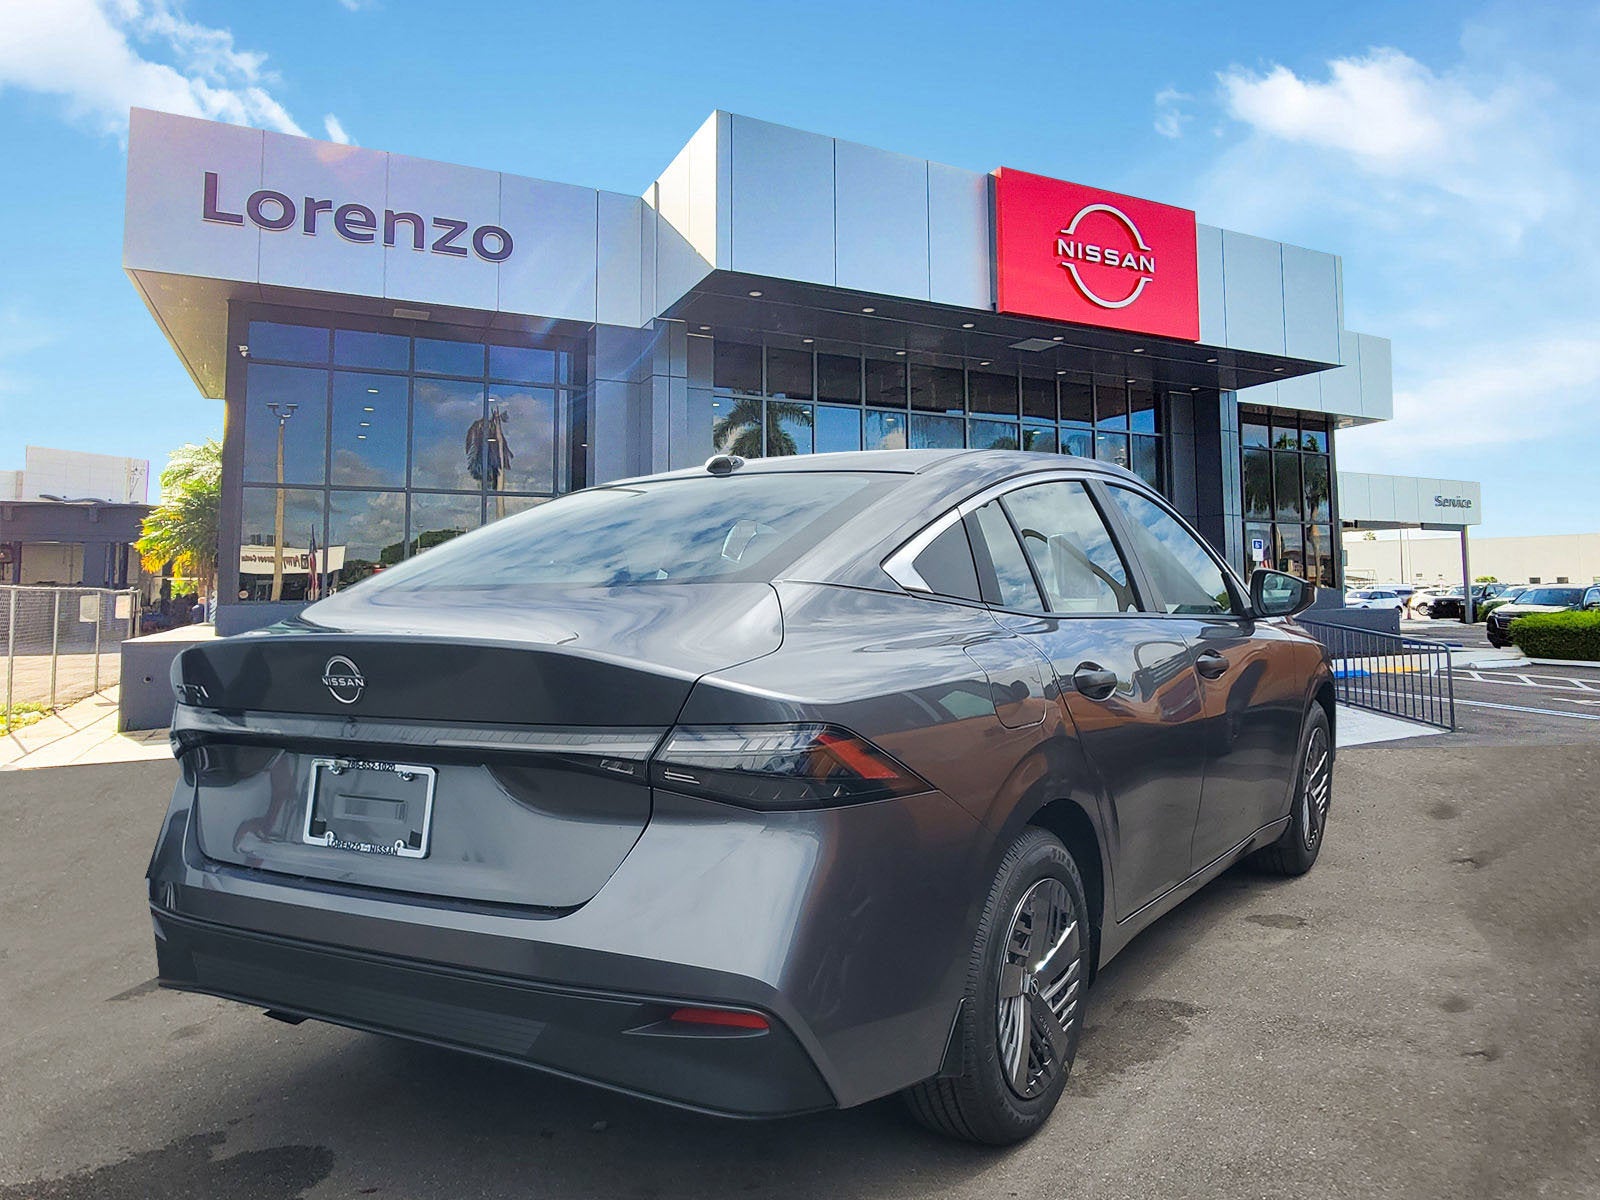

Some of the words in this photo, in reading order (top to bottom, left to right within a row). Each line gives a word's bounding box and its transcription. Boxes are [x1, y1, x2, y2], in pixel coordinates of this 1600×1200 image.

[202, 171, 514, 262] Lorenzo
[1057, 238, 1155, 273] NISSAN
[1434, 495, 1472, 508] Service
[322, 677, 364, 687] NISSAN
[326, 838, 362, 851] LORENZO
[369, 843, 398, 856] NISSAN
